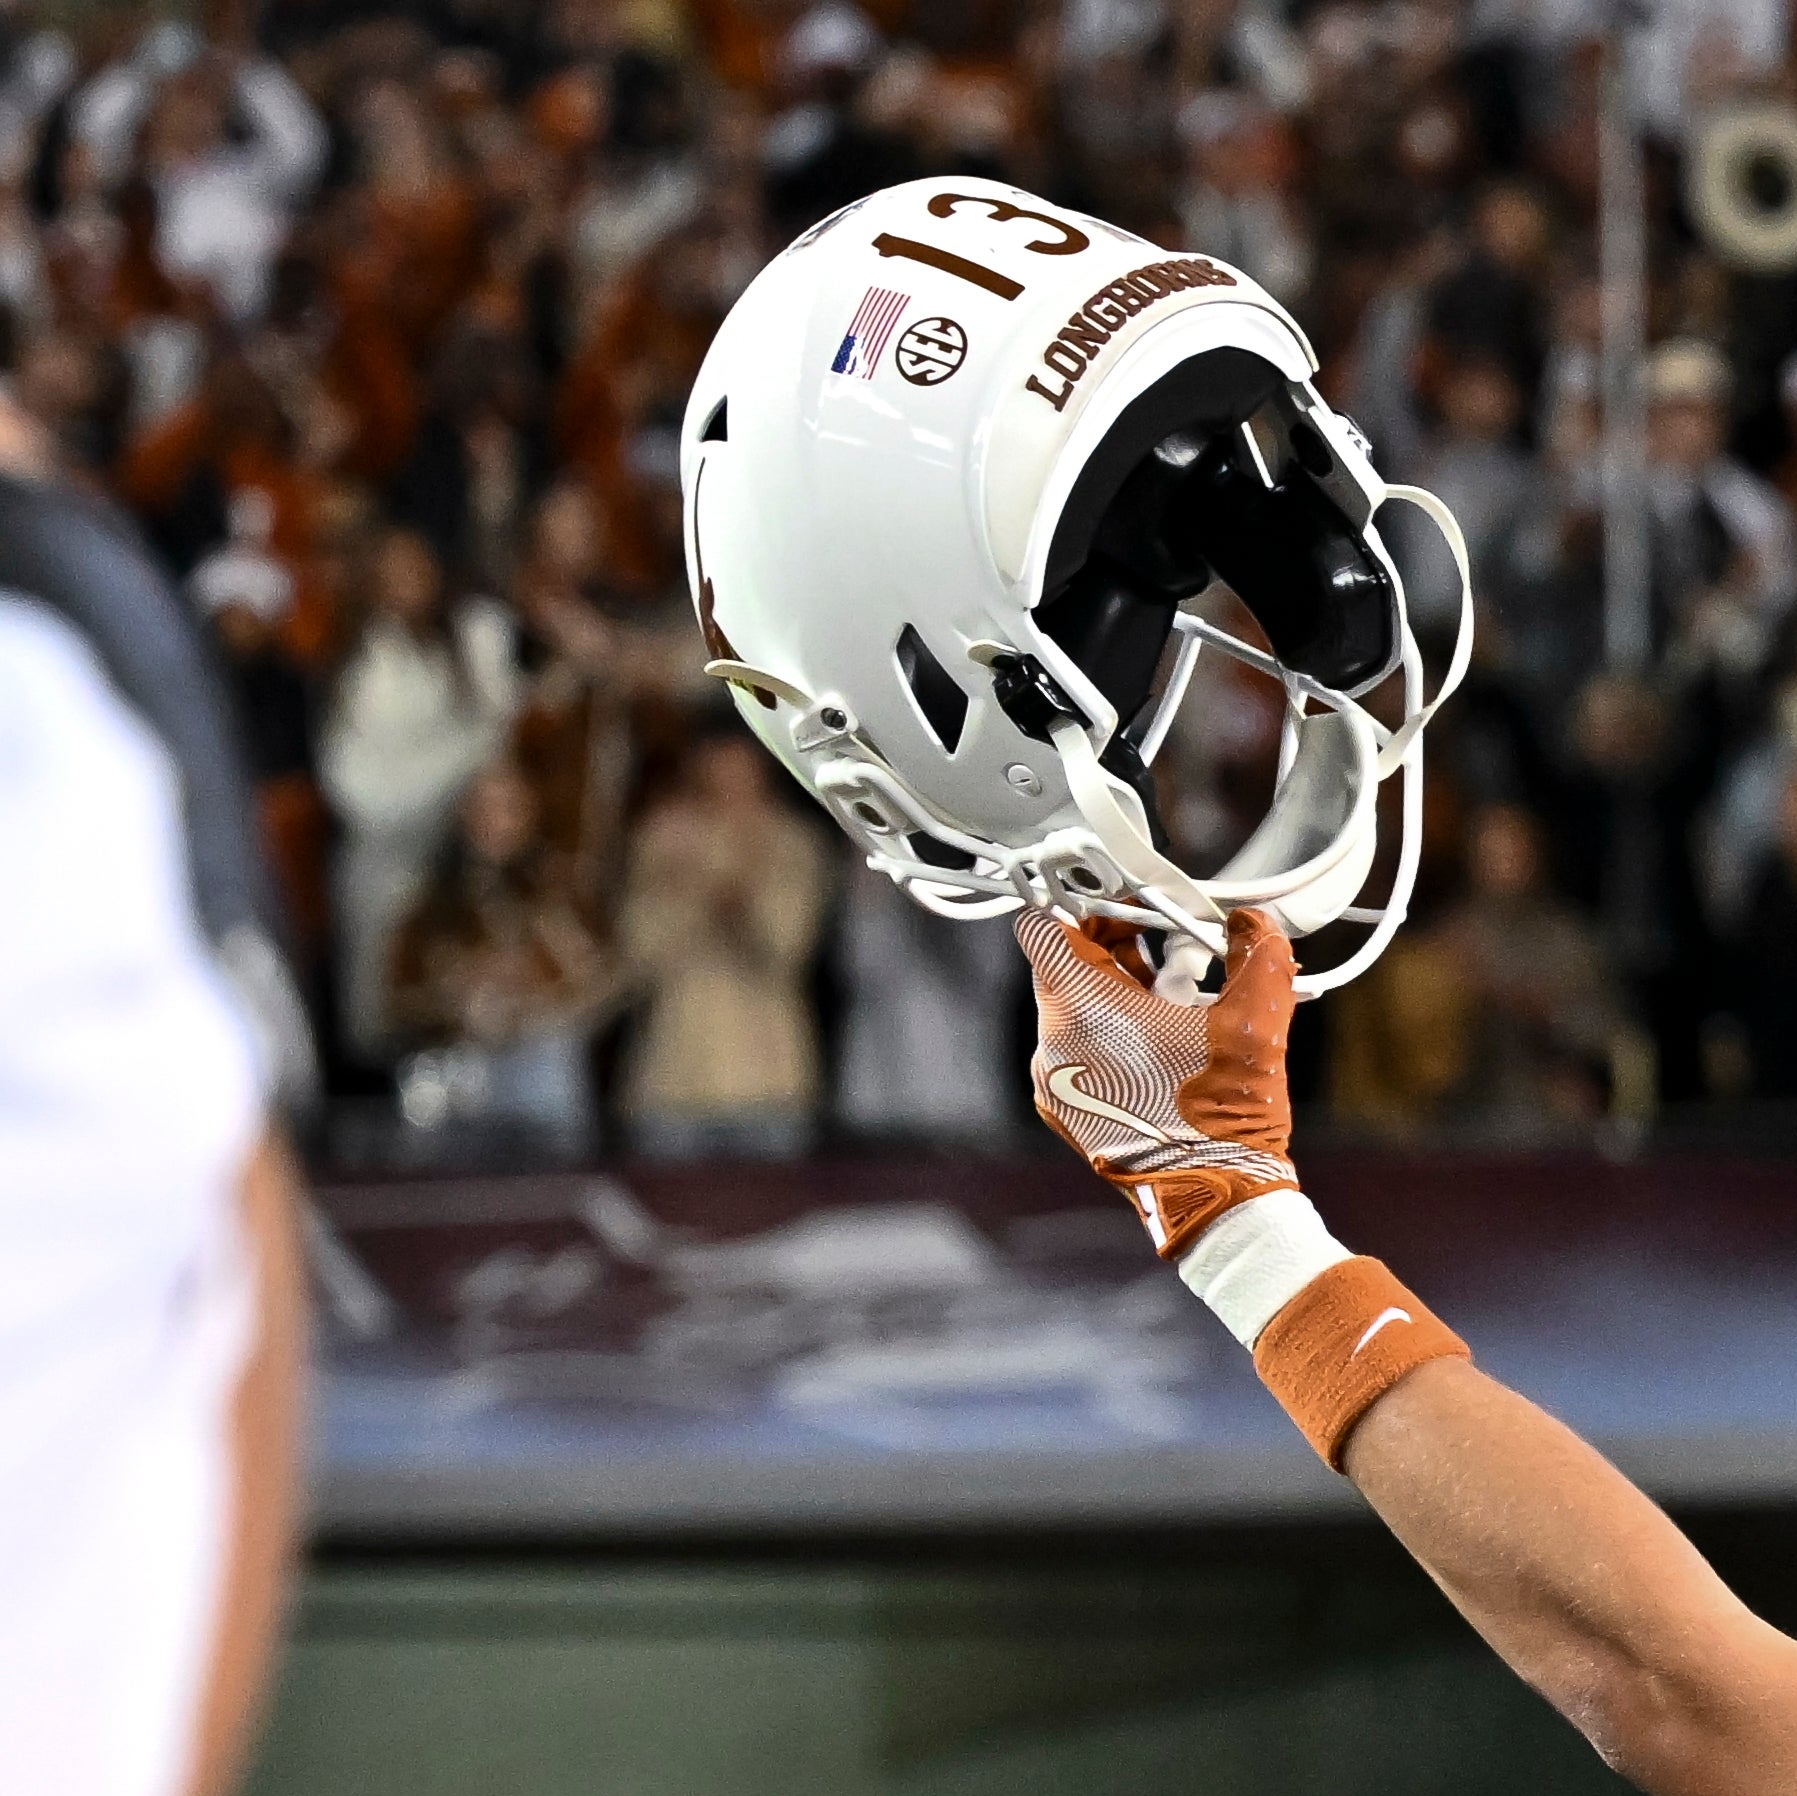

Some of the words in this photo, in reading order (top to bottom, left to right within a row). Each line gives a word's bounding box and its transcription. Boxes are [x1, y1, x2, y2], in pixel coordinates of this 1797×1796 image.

[871, 193, 1091, 302] 13
[897, 317, 967, 386] SEC
[1025, 258, 1237, 413] LONGHORNS
